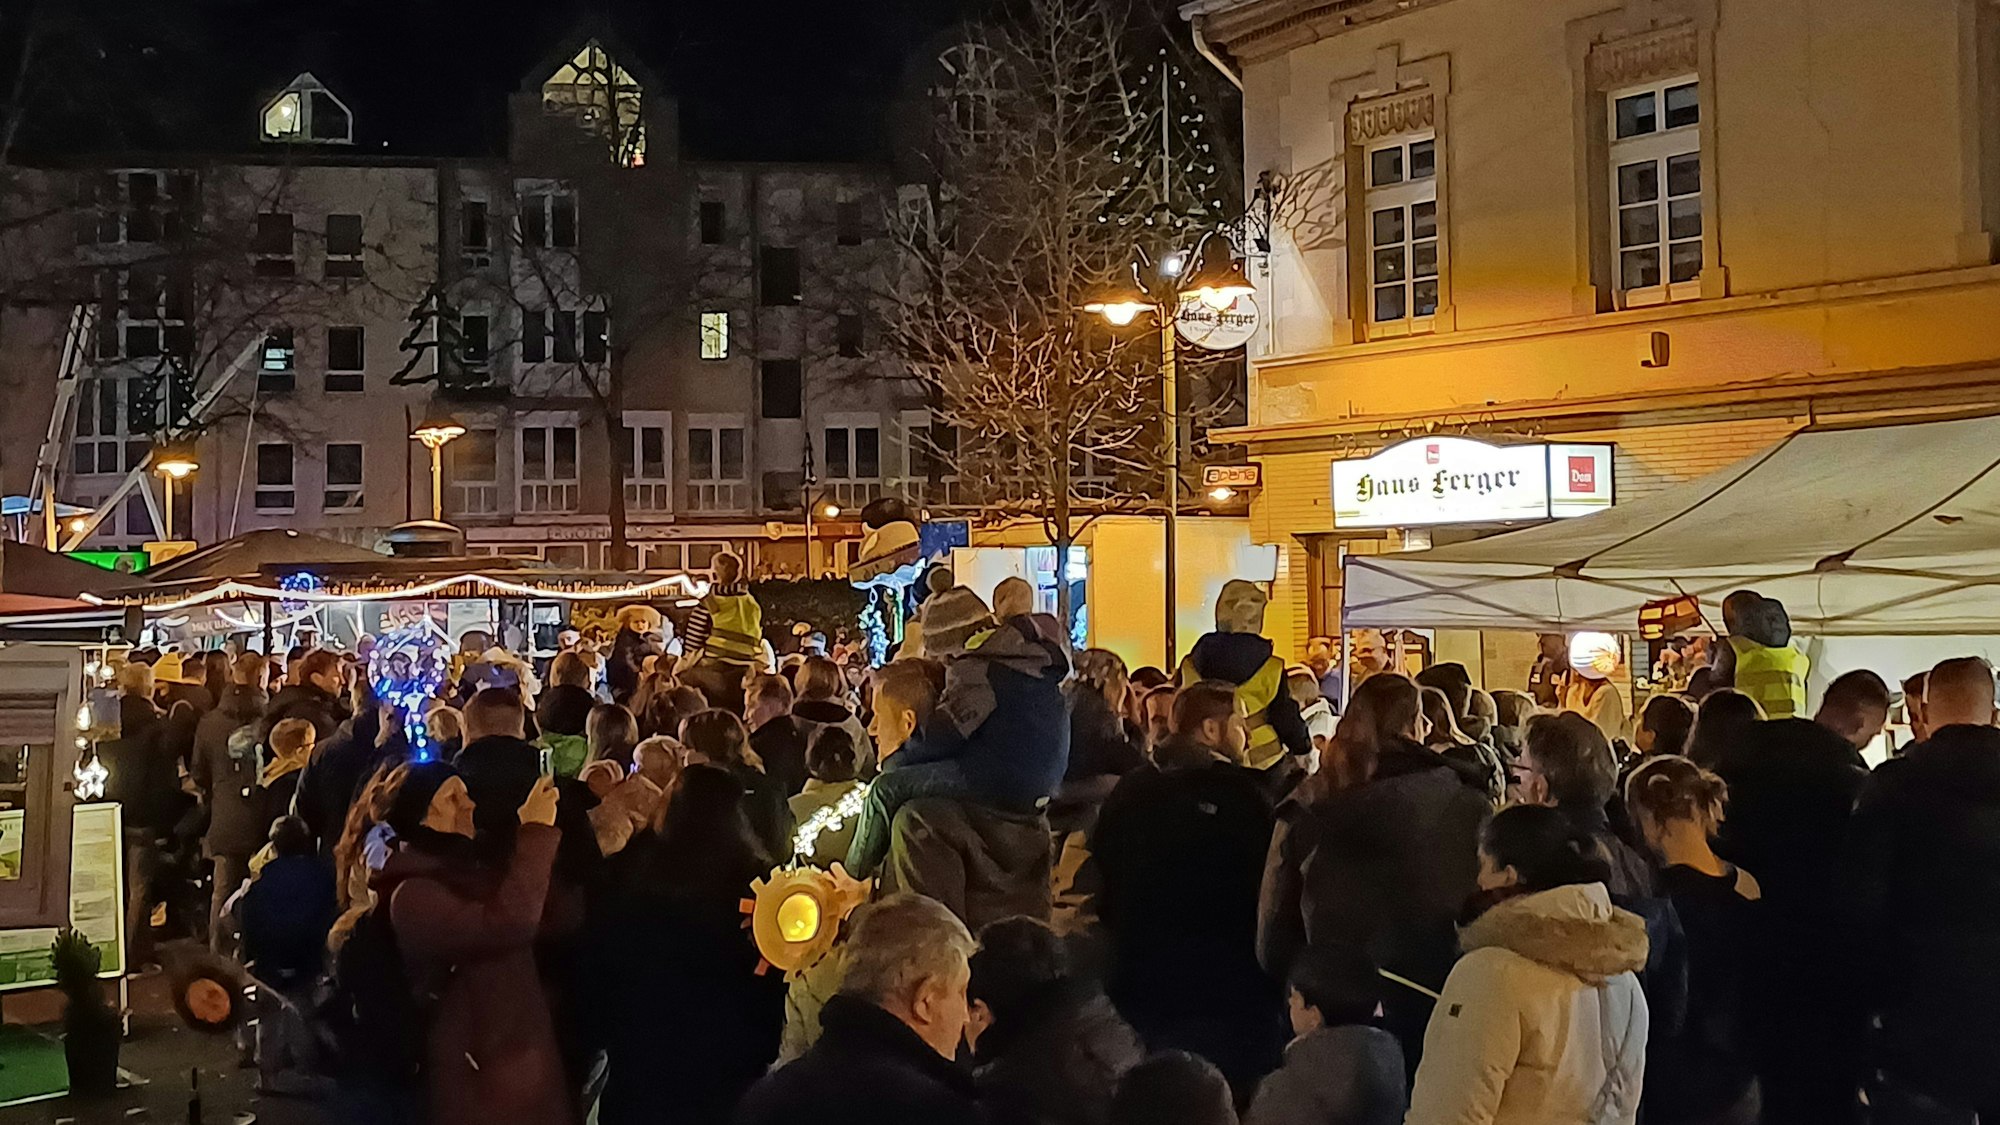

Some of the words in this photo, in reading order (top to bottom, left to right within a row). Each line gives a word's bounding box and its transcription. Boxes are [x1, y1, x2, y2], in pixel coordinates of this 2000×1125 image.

[1181, 308, 1212, 324] Haus
[1571, 469, 1592, 482] Dom
[1356, 474, 1420, 502] Haus
[1432, 469, 1520, 499] Ferger
